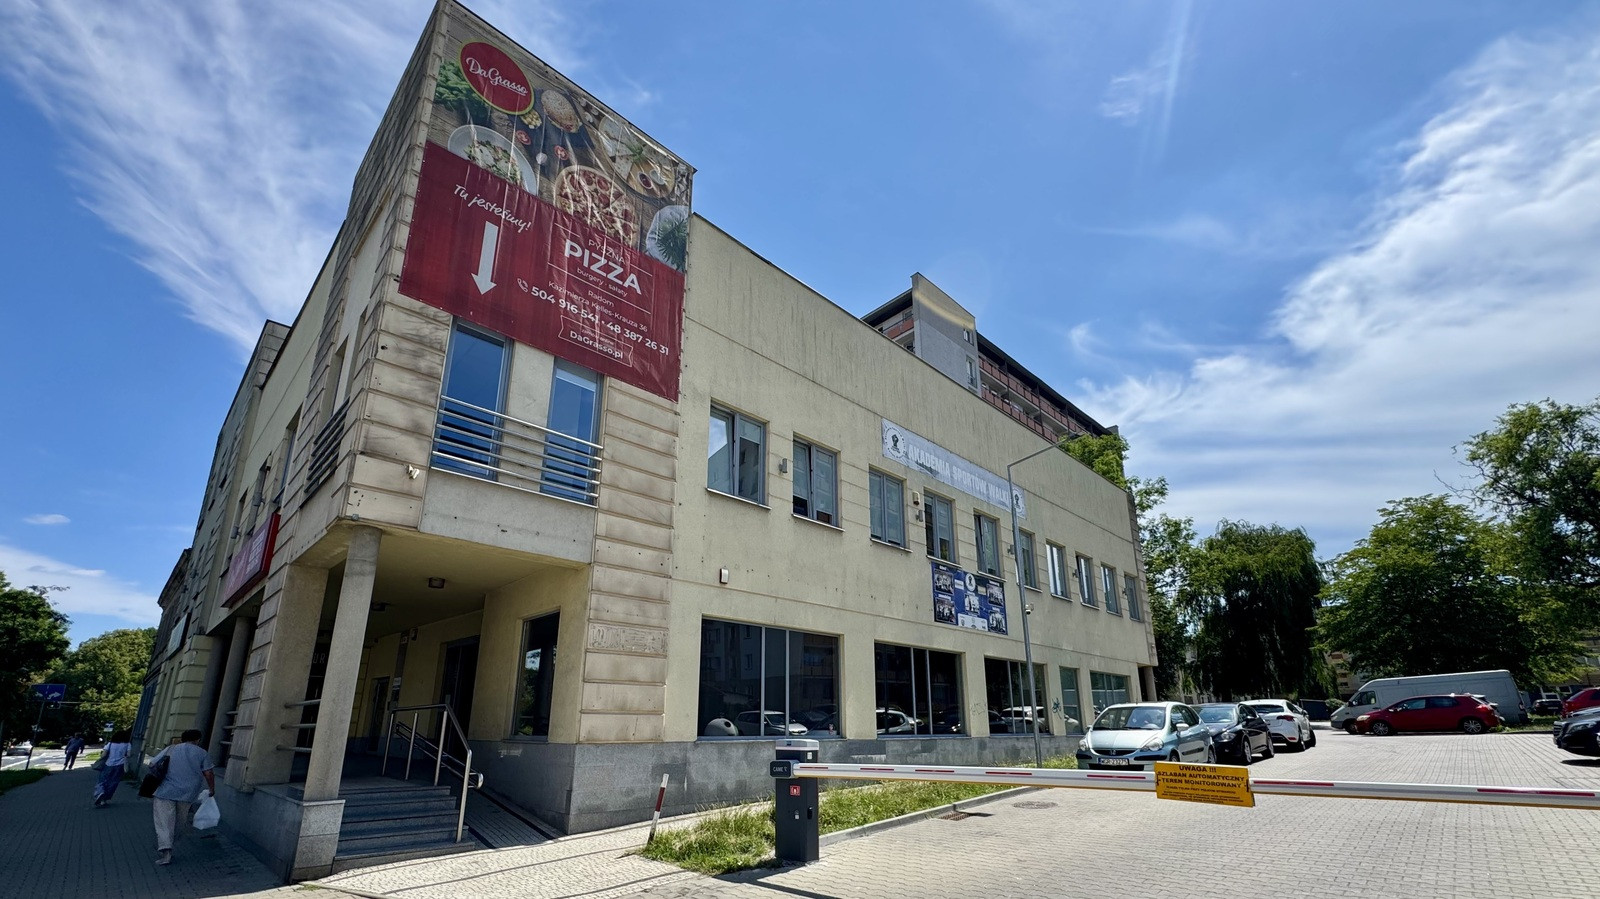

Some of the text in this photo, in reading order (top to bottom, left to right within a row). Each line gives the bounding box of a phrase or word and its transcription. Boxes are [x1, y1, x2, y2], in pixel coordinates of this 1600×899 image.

[466, 57, 528, 96] DaGrasso
[454, 184, 532, 233] Tu jesteśmy!
[588, 239, 626, 264] PYSZNA
[564, 239, 642, 295] PIZZA
[577, 267, 604, 286] burgery
[548, 281, 590, 305] Kazimierza
[591, 302, 638, 327] Kelles-Krauza
[588, 290, 615, 307] Radom
[531, 286, 556, 304] 504
[559, 299, 579, 314] 916
[580, 309, 599, 324] 541
[606, 321, 621, 334] 48
[623, 328, 643, 343] 387
[645, 338, 658, 350] 26
[659, 344, 669, 356] 31
[570, 330, 624, 359] DaGrasso.pl
[908, 444, 951, 478] AKADEMIA
[952, 465, 987, 492] SPORTÓW
[988, 484, 1010, 501] WALKI
[1178, 765, 1208, 773] UWAGA
[1188, 773, 1245, 782] AUTOMATYCZNY
[1184, 780, 1242, 788] MONITOROWANY
